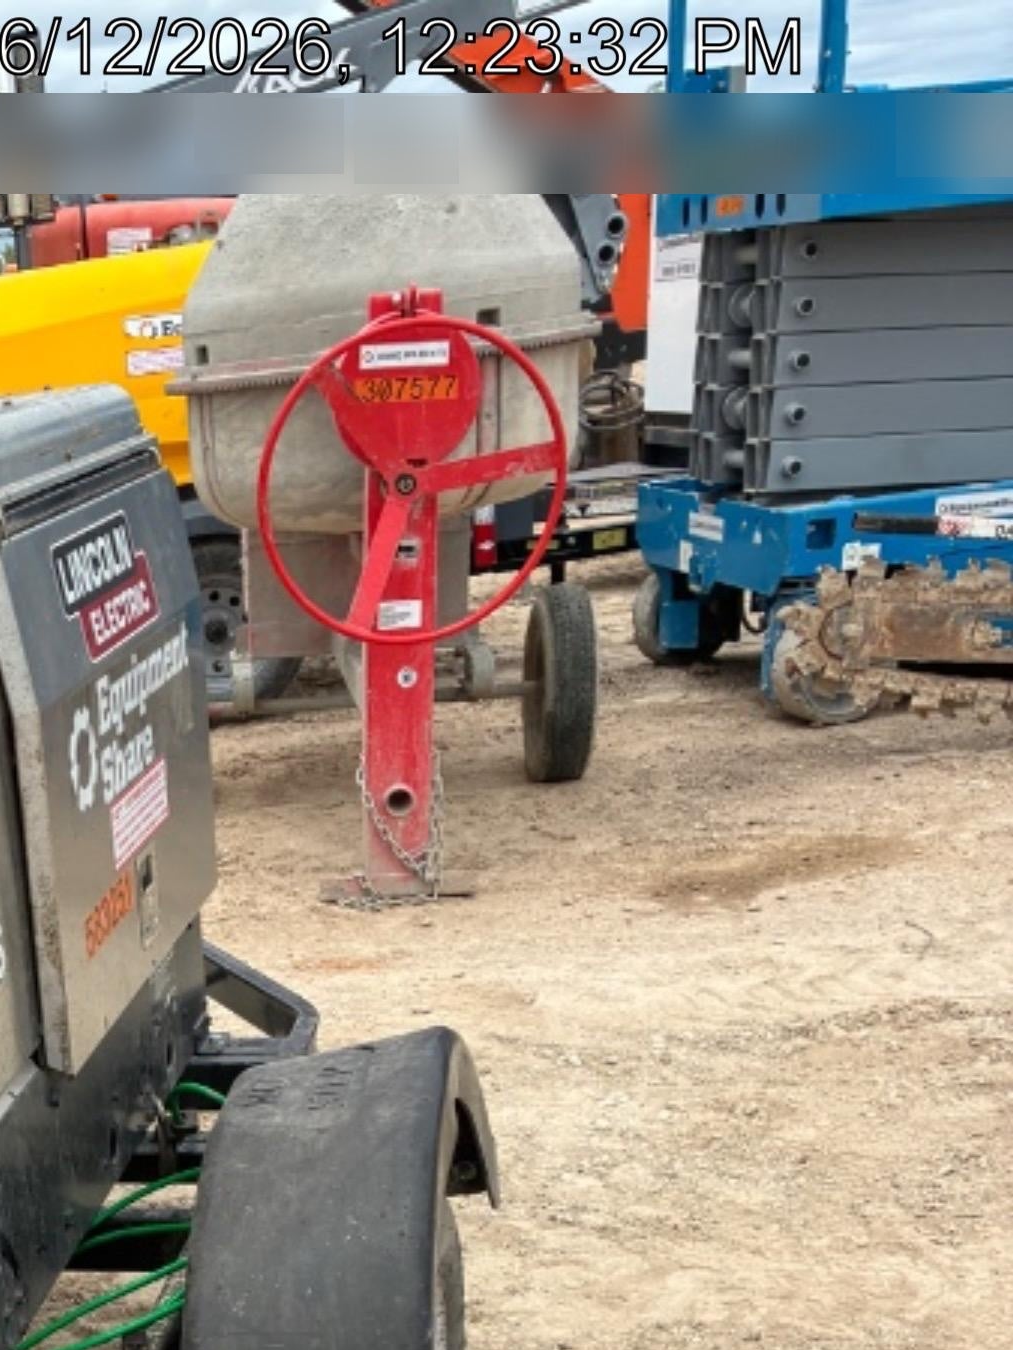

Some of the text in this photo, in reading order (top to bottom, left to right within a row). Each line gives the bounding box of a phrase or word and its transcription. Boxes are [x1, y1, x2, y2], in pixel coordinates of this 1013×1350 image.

[362, 373, 457, 402] 307577
[58, 525, 133, 604] LINCOLN
[90, 580, 151, 645] ELECTRIC
[97, 622, 188, 736] Equipment
[100, 724, 156, 803] Share
